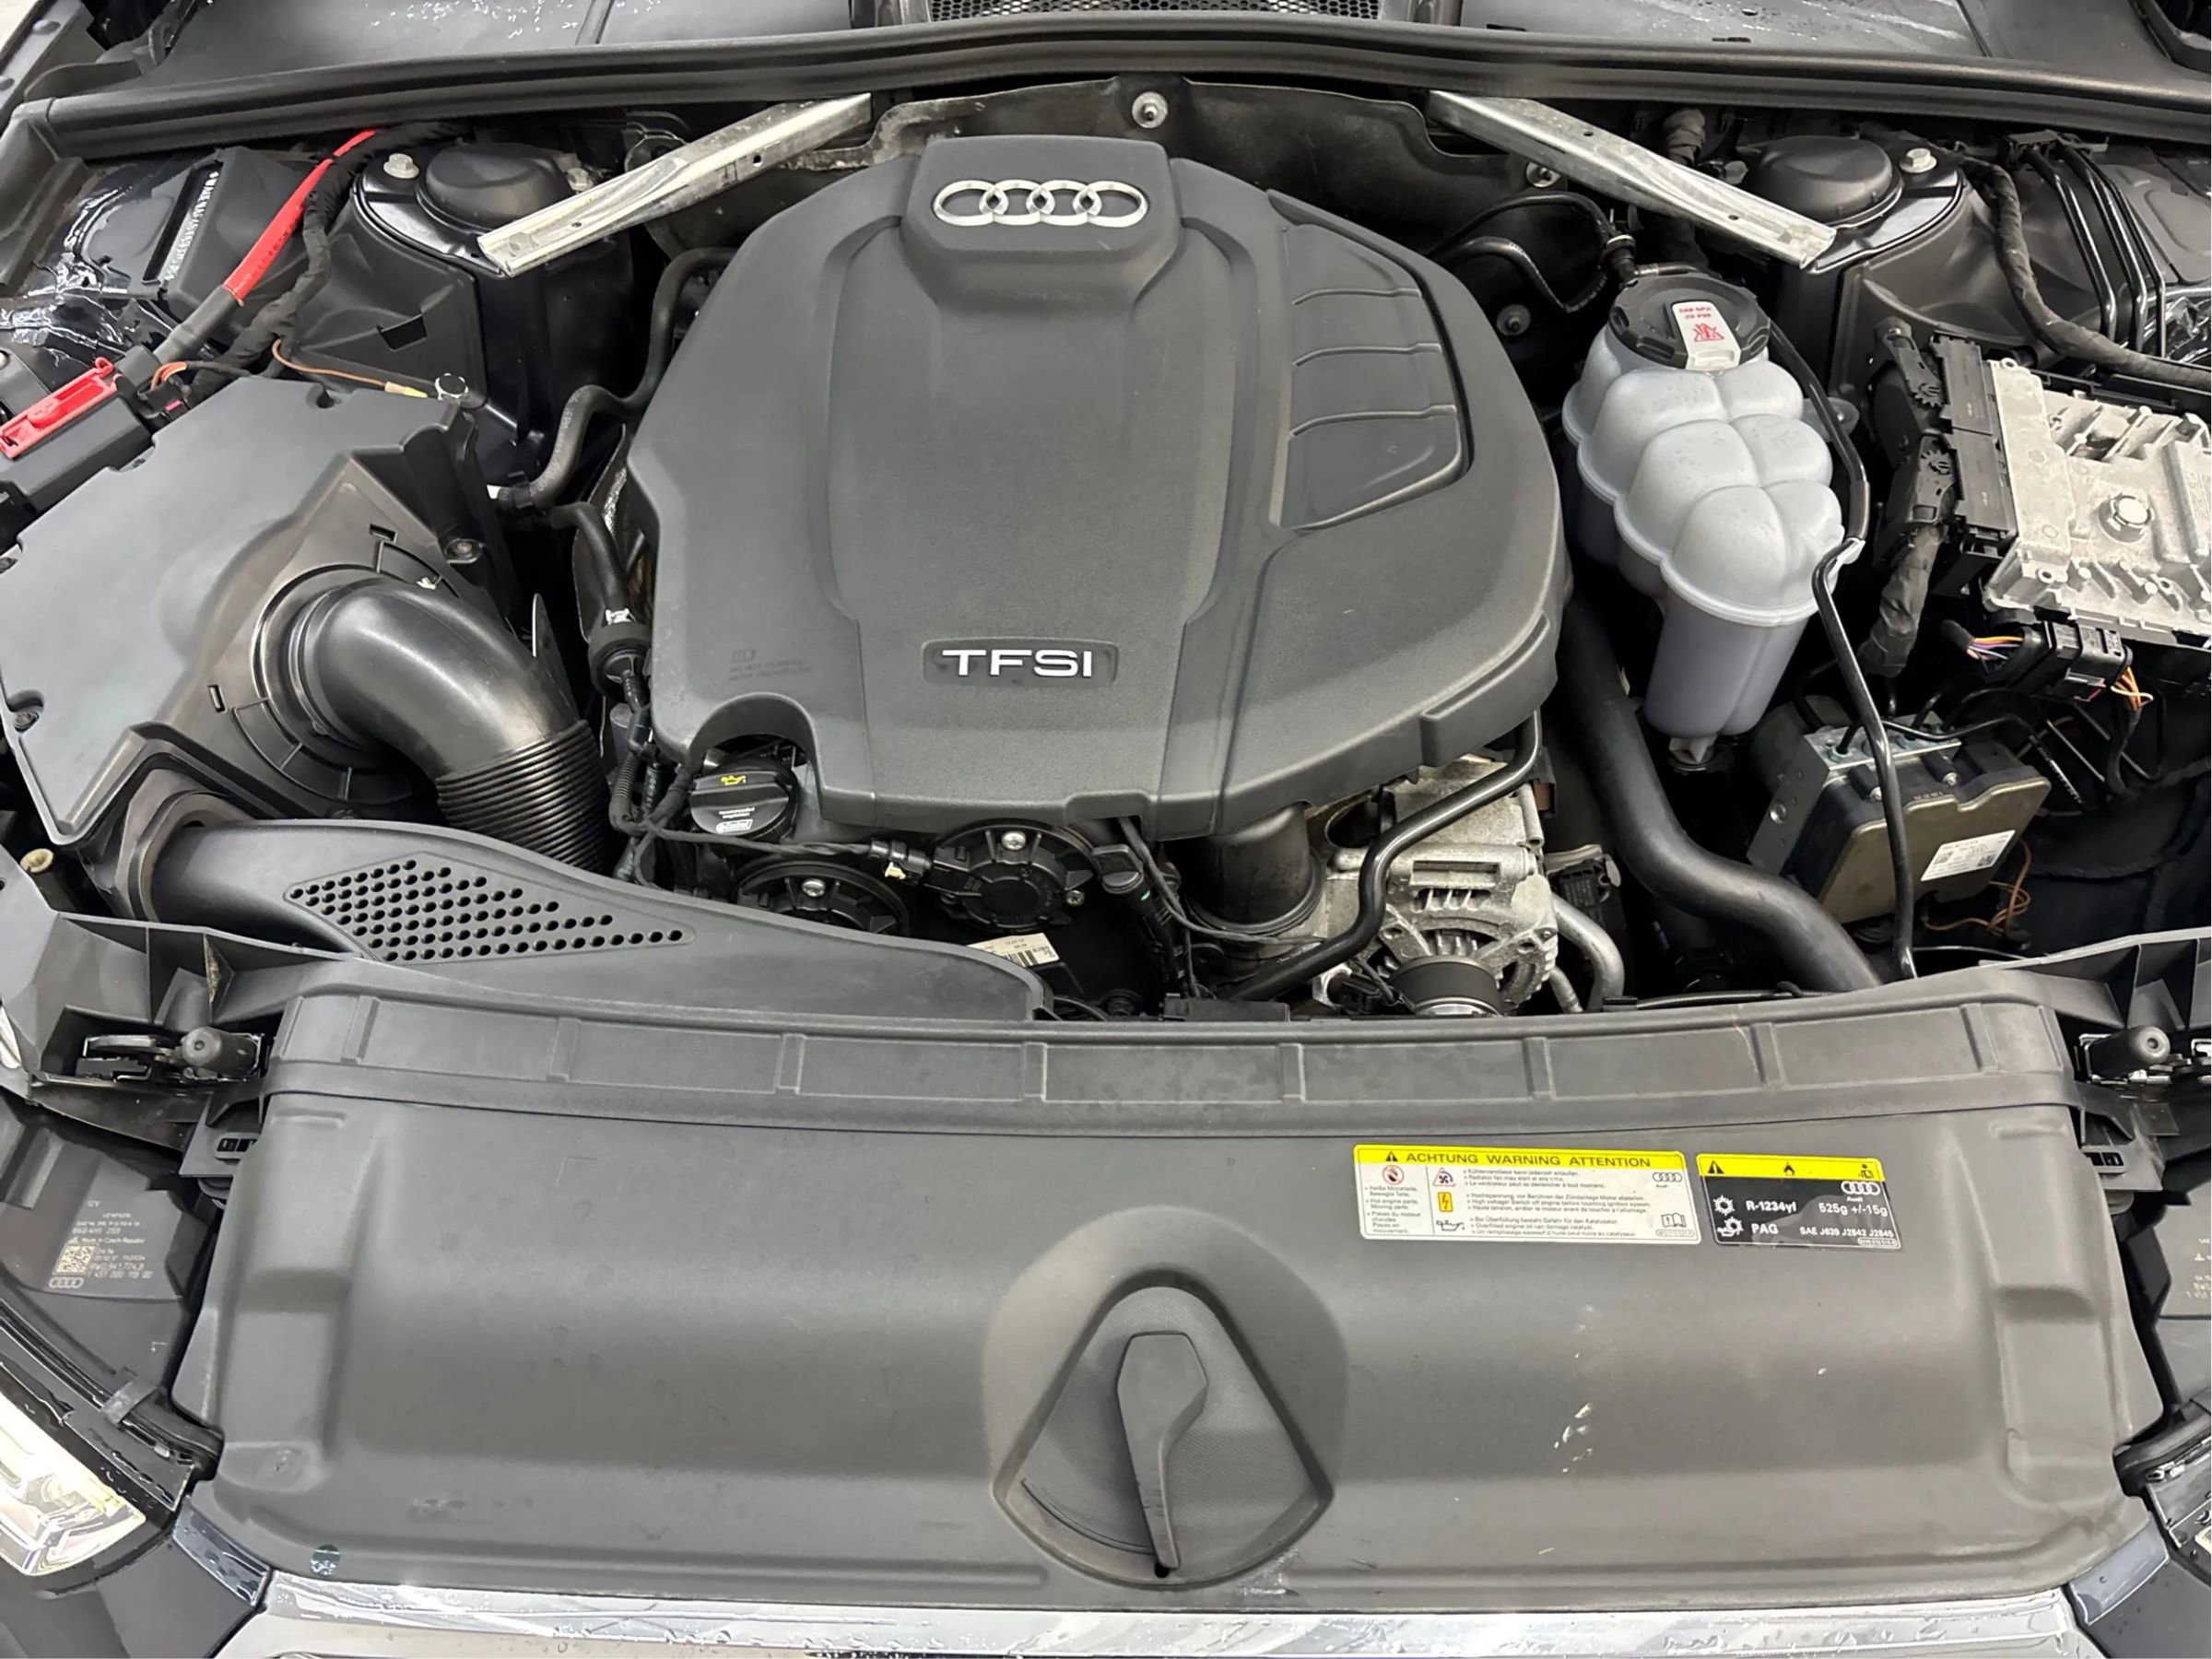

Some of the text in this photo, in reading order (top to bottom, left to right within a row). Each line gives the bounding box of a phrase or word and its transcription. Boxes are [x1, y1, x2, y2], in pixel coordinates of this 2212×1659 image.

[942, 649, 1092, 677] TFSI
[1406, 1153, 1651, 1168] ACHTUNG WARNING ATTENTION
[1746, 1200, 1888, 1217] R-1234yf 525g +/-15g
[1751, 1223, 1893, 1238] PAG SAE J639 J2842 J2845
